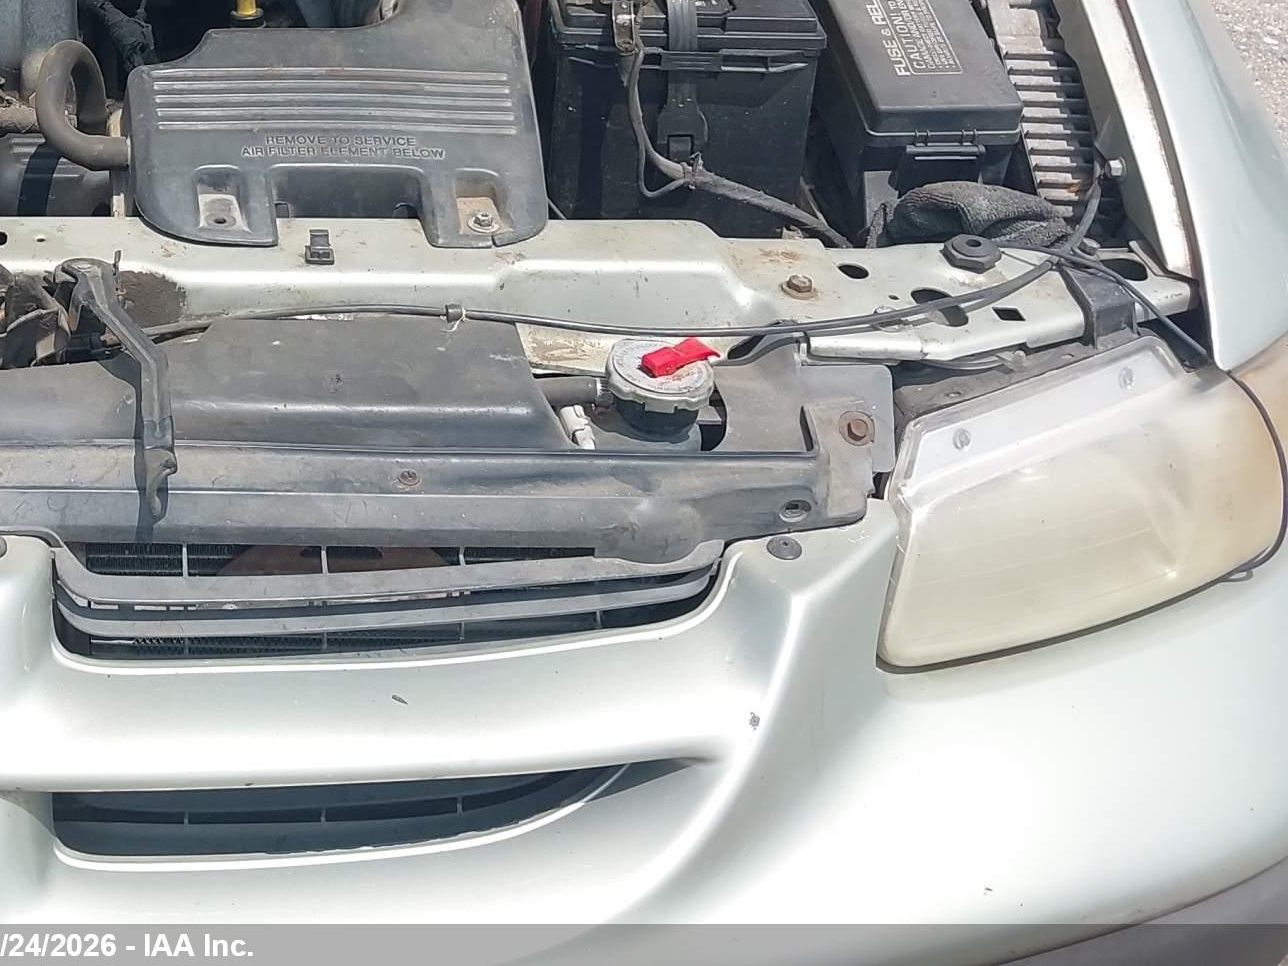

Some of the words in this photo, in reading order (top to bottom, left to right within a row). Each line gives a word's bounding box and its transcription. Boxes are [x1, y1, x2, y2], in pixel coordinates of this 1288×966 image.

[879, 27, 891, 35] &
[888, 12, 926, 68] CAUTION!
[882, 39, 911, 75] FUSE
[265, 135, 326, 146] REMOVE
[332, 136, 351, 146] TO
[354, 136, 417, 147] SERVICE
[241, 146, 266, 158] AIR
[268, 146, 316, 158] FILTER
[320, 146, 389, 158] ELEMENT
[392, 148, 446, 160] BELOW
